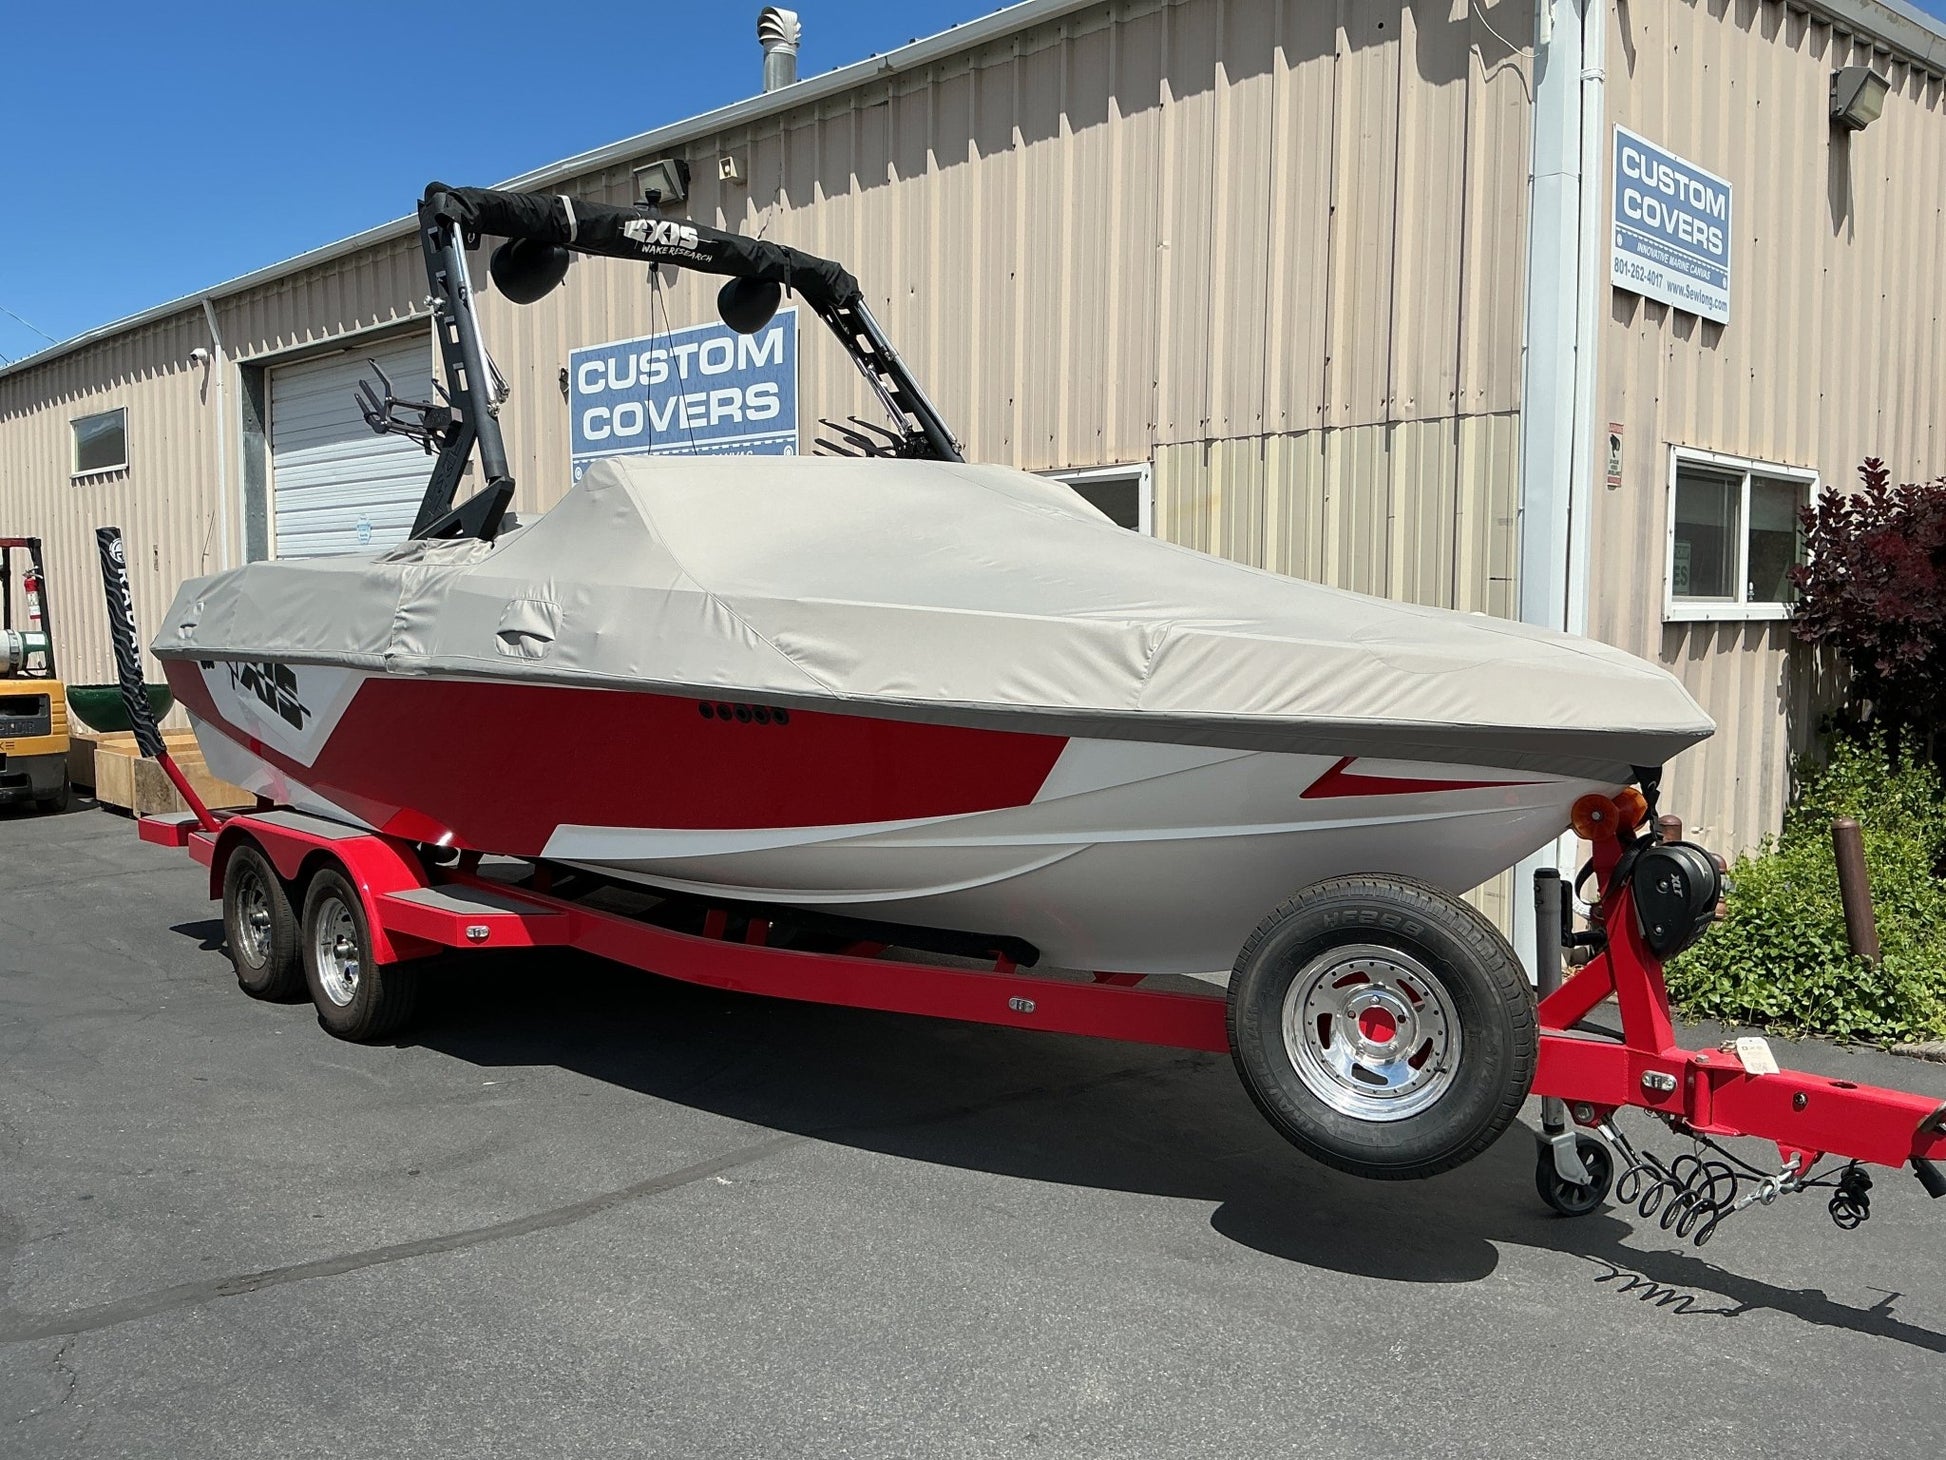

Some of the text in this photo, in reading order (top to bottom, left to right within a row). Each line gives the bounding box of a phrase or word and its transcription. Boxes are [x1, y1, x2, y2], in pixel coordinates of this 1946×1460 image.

[1622, 147, 1726, 221] CUSTOM
[1624, 187, 1723, 256] COVERS
[641, 243, 713, 263] WAKE RESEARCH
[1614, 257, 1664, 289] 801-262-4017
[1636, 241, 1711, 281] INNOVATIVE MARINE CANVAS
[578, 327, 784, 395] CUSTOM
[583, 381, 780, 441] COVERS
